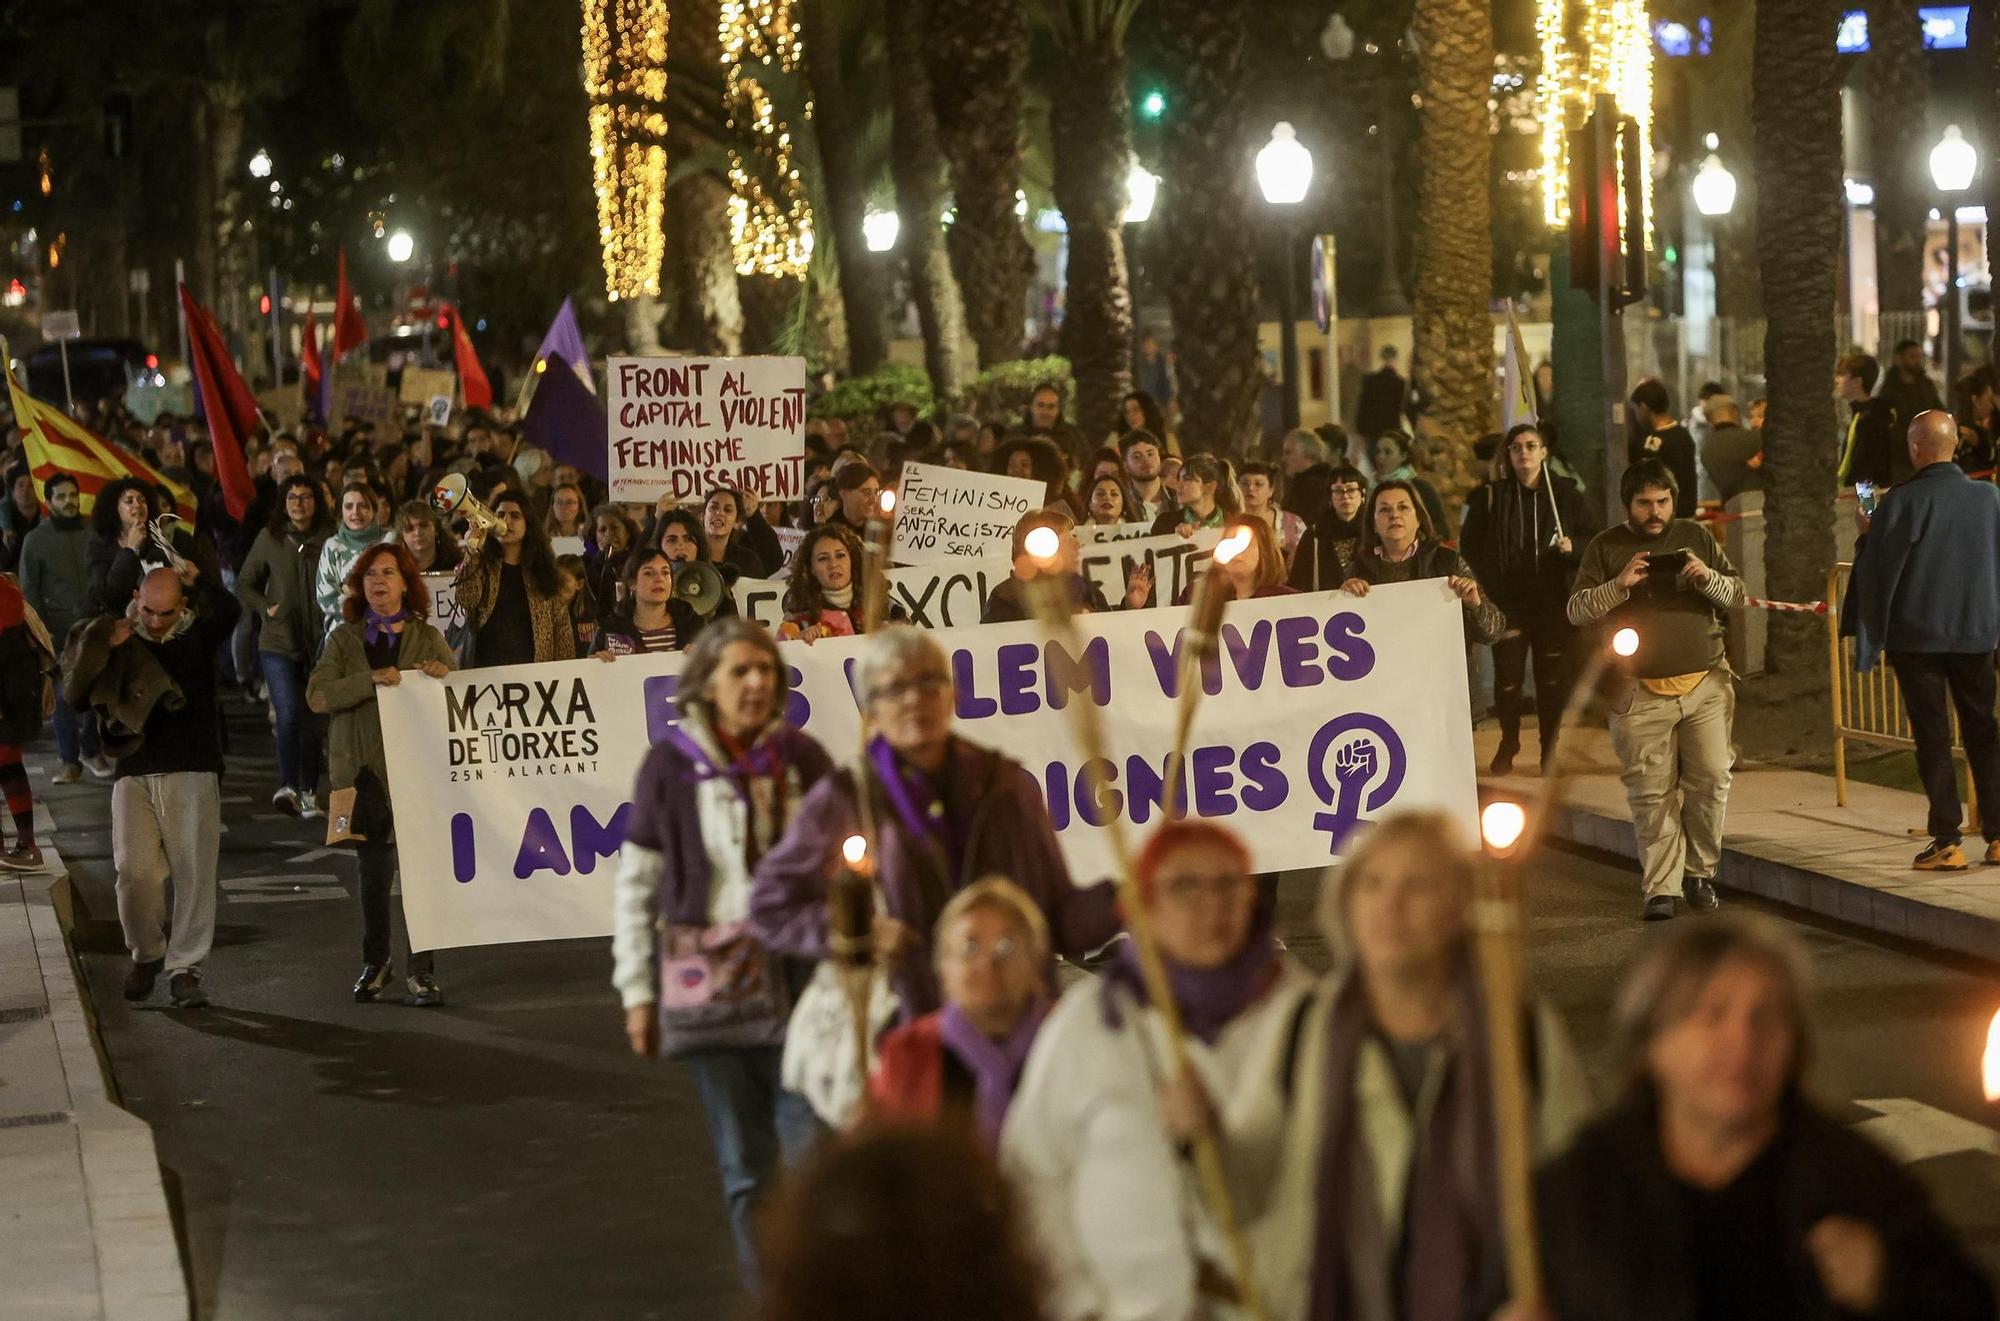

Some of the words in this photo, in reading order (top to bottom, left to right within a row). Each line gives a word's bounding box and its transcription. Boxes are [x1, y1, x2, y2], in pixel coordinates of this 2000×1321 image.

[618, 364, 710, 398] FRONT
[719, 371, 752, 398] AL
[619, 400, 711, 429] CAPITAL
[719, 387, 805, 435] VIOLENT
[613, 436, 746, 470] FEMINISME
[905, 465, 919, 475] EL
[671, 456, 805, 499] DISSIDENT
[902, 504, 937, 517] SERÁ
[908, 533, 937, 550] NO
[943, 541, 986, 558] SERÁ
[1144, 611, 1376, 699] VIVES
[444, 677, 597, 733] MARXA
[450, 769, 484, 783] 25N
[507, 760, 598, 778] ALACANT
[450, 812, 477, 884] I
